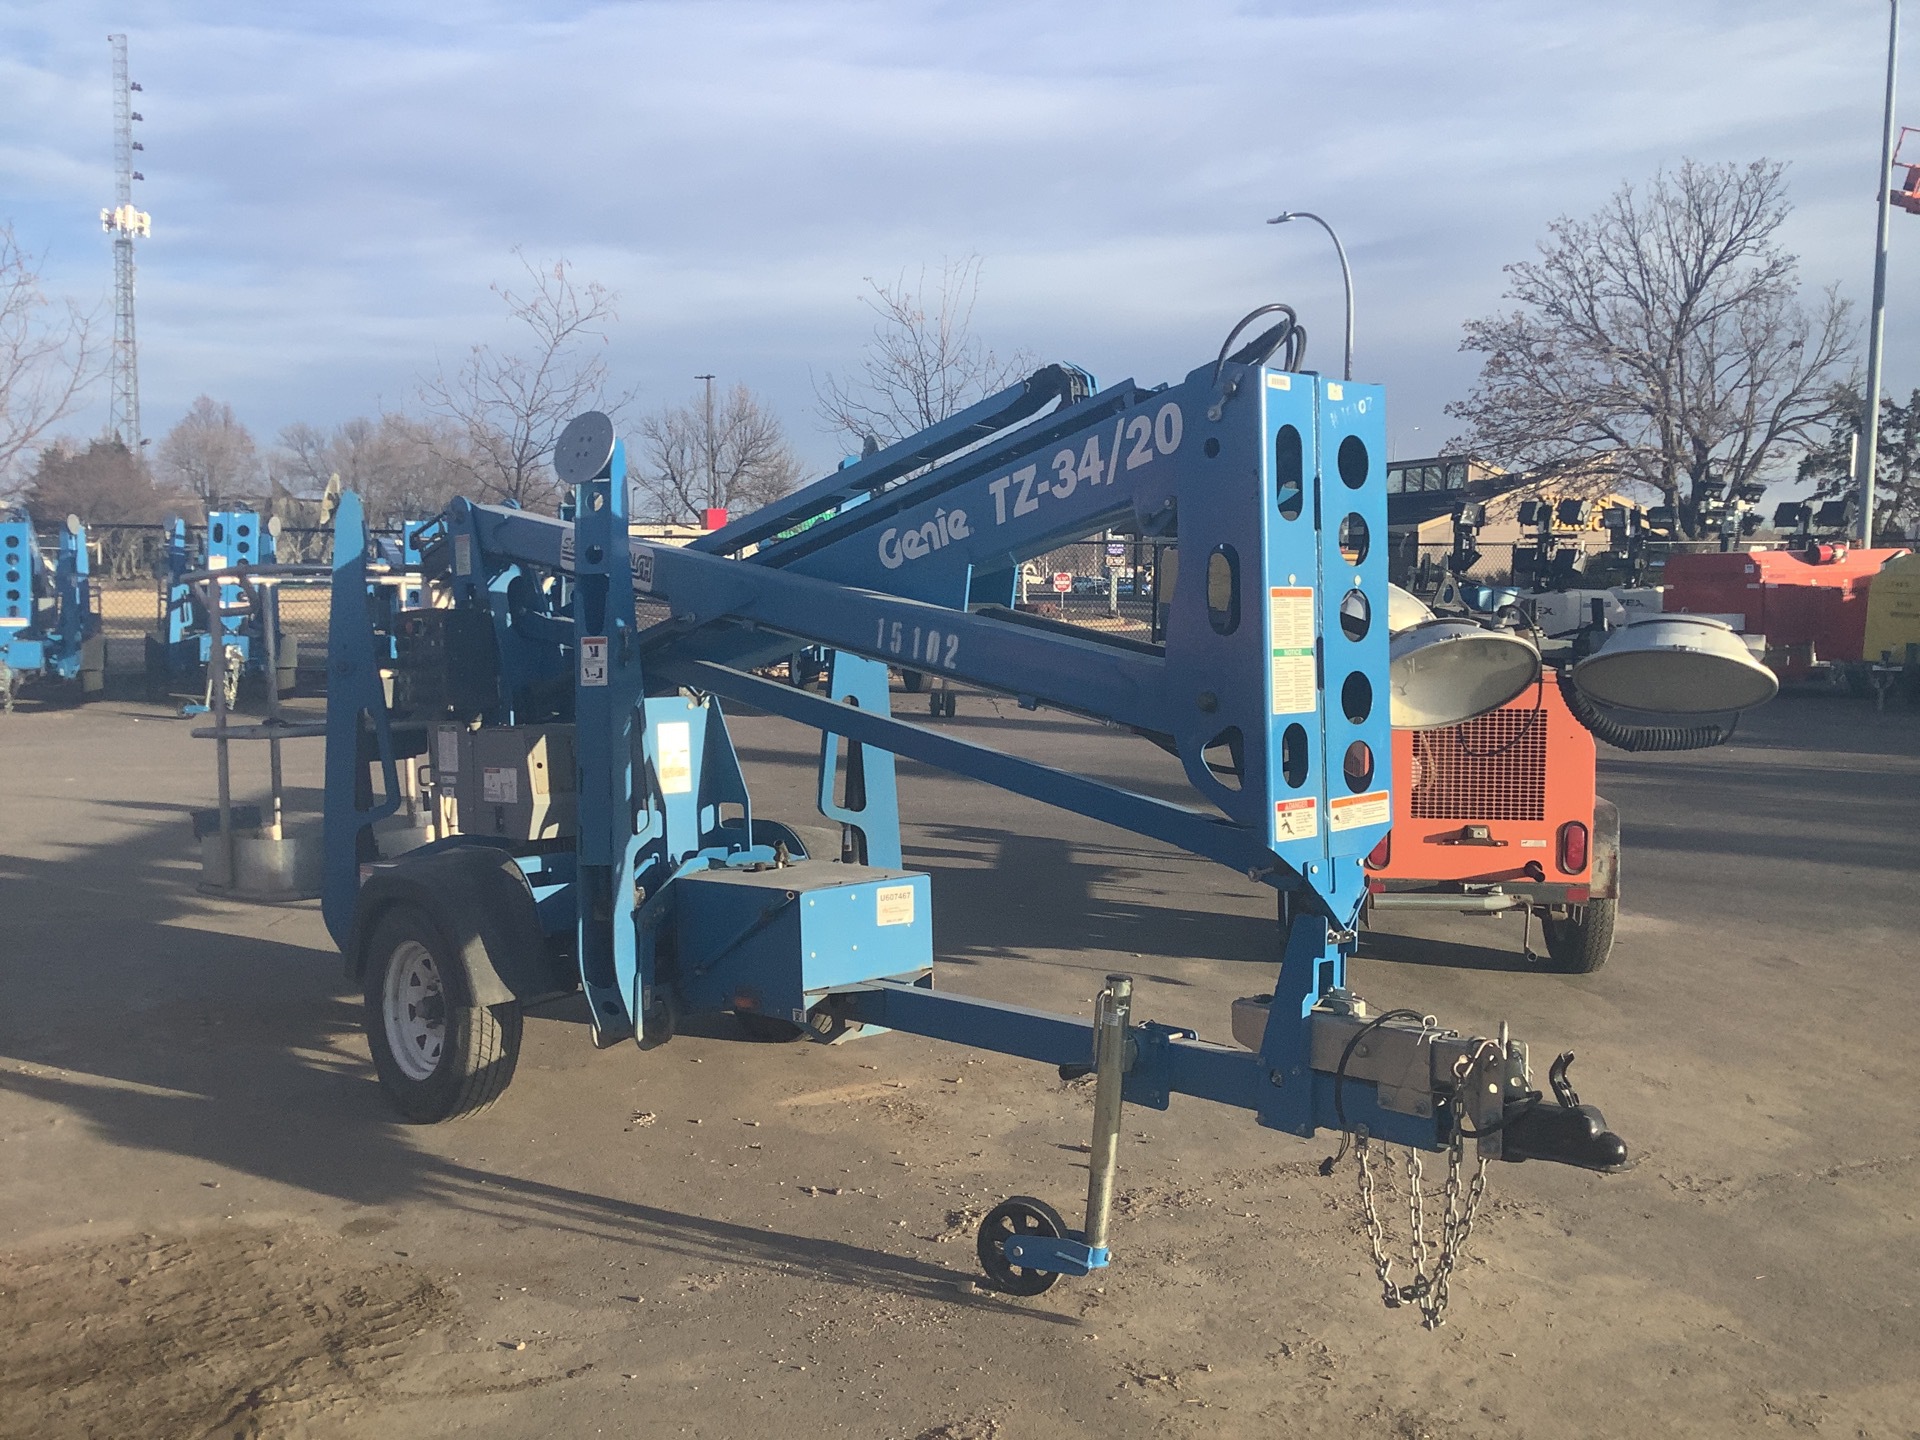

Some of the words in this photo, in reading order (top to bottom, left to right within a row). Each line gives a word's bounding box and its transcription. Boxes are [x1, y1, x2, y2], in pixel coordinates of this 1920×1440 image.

[989, 402, 1183, 525] TZ-34/20
[878, 508, 970, 569] Genie
[876, 618, 959, 669] 15102
